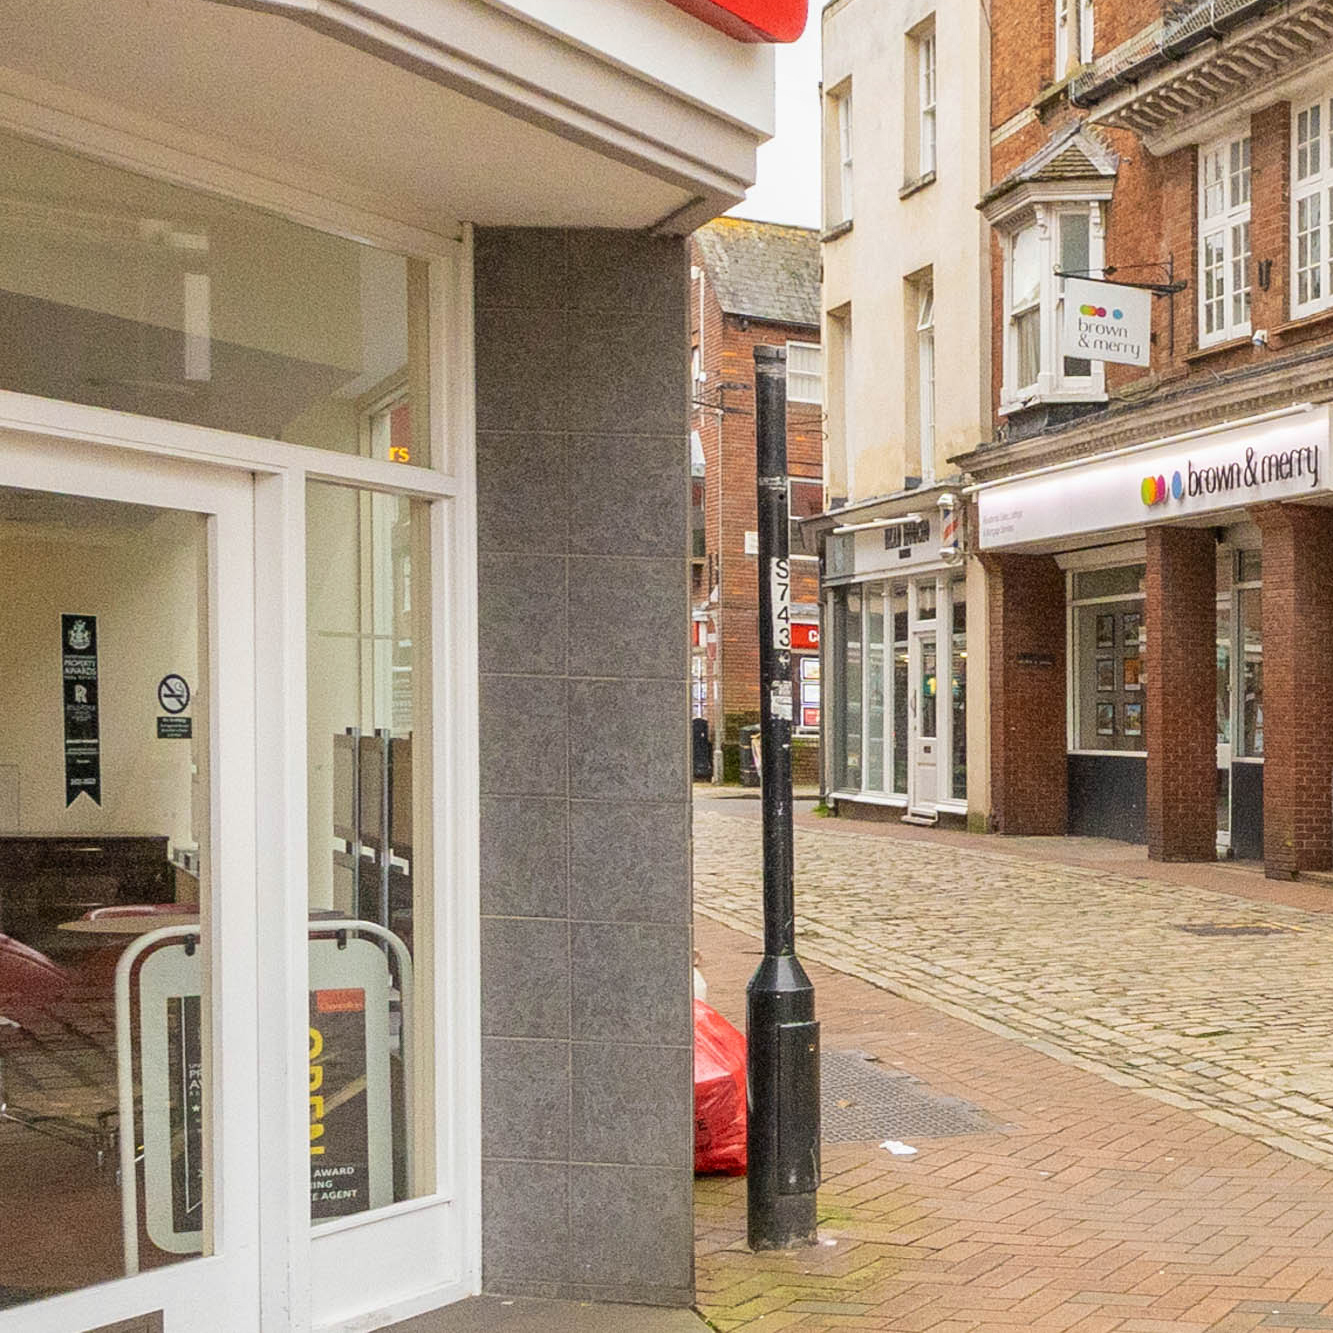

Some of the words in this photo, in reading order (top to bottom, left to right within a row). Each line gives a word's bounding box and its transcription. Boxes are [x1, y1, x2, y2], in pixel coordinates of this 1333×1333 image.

[1078, 317, 1129, 339] brown
[1078, 333, 1089, 348] &
[1093, 338, 1141, 360] merry
[1187, 459, 1241, 498] brown
[1244, 446, 1258, 487] &
[1261, 444, 1319, 488] merry
[313, 1166, 355, 1178] AWARD
[320, 1189, 358, 1200] AGENT
